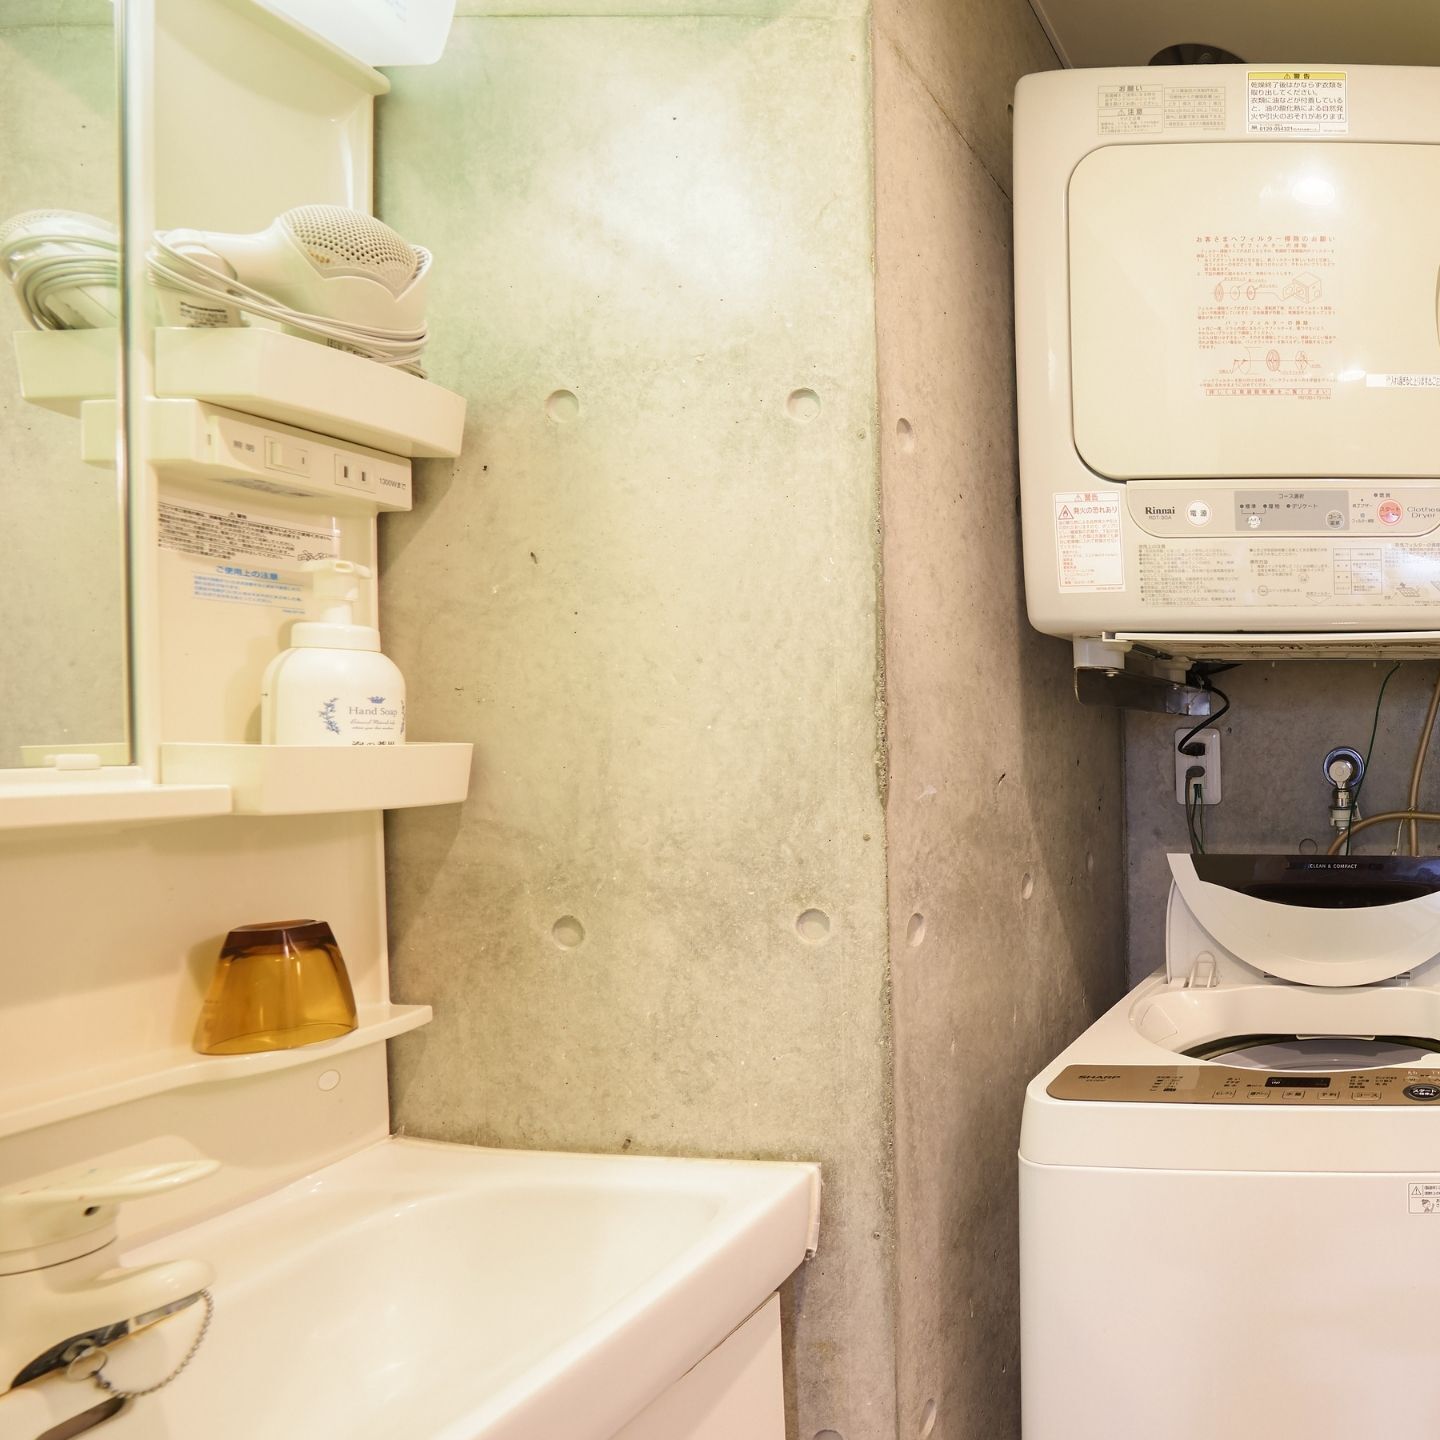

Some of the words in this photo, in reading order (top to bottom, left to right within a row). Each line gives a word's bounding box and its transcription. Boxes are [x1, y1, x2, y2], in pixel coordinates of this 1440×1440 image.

[1144, 506, 1176, 515] Rinnai
[348, 706, 378, 716] Hand
[379, 707, 398, 717] Soap
